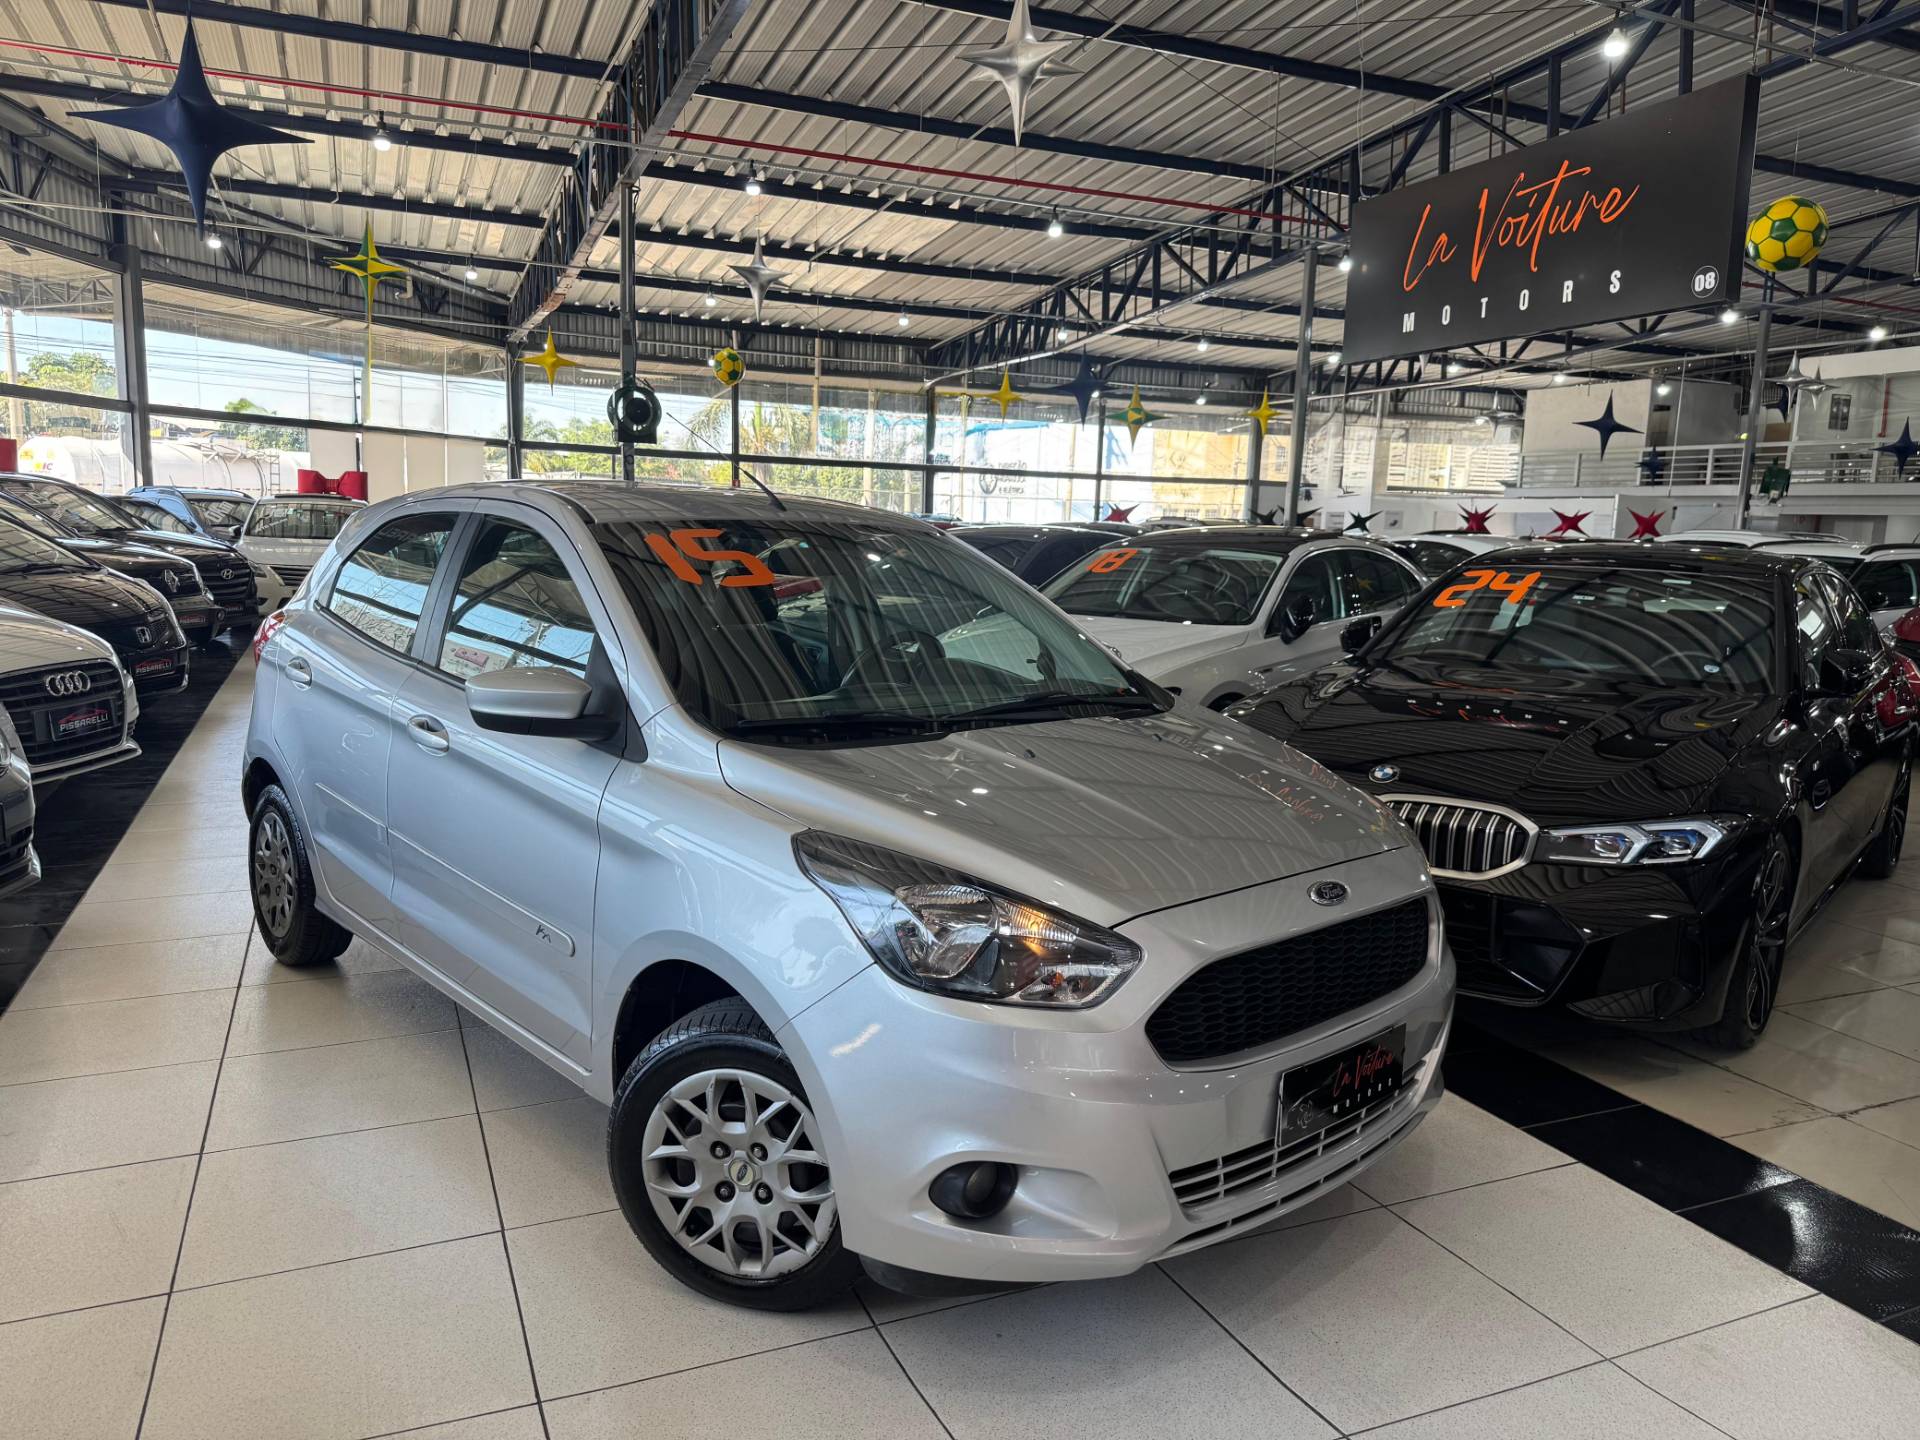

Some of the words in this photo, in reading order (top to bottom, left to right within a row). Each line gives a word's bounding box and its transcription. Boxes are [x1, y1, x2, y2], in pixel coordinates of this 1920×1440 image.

[1403, 203, 1458, 292] La
[1470, 159, 1641, 283] Voiture
[1694, 271, 1717, 292] 08
[1402, 269, 1622, 334] MOTORS
[643, 527, 775, 587] 15
[1087, 547, 1137, 574] 18
[1433, 569, 1542, 608] 24
[60, 713, 109, 732] PISSARELLI
